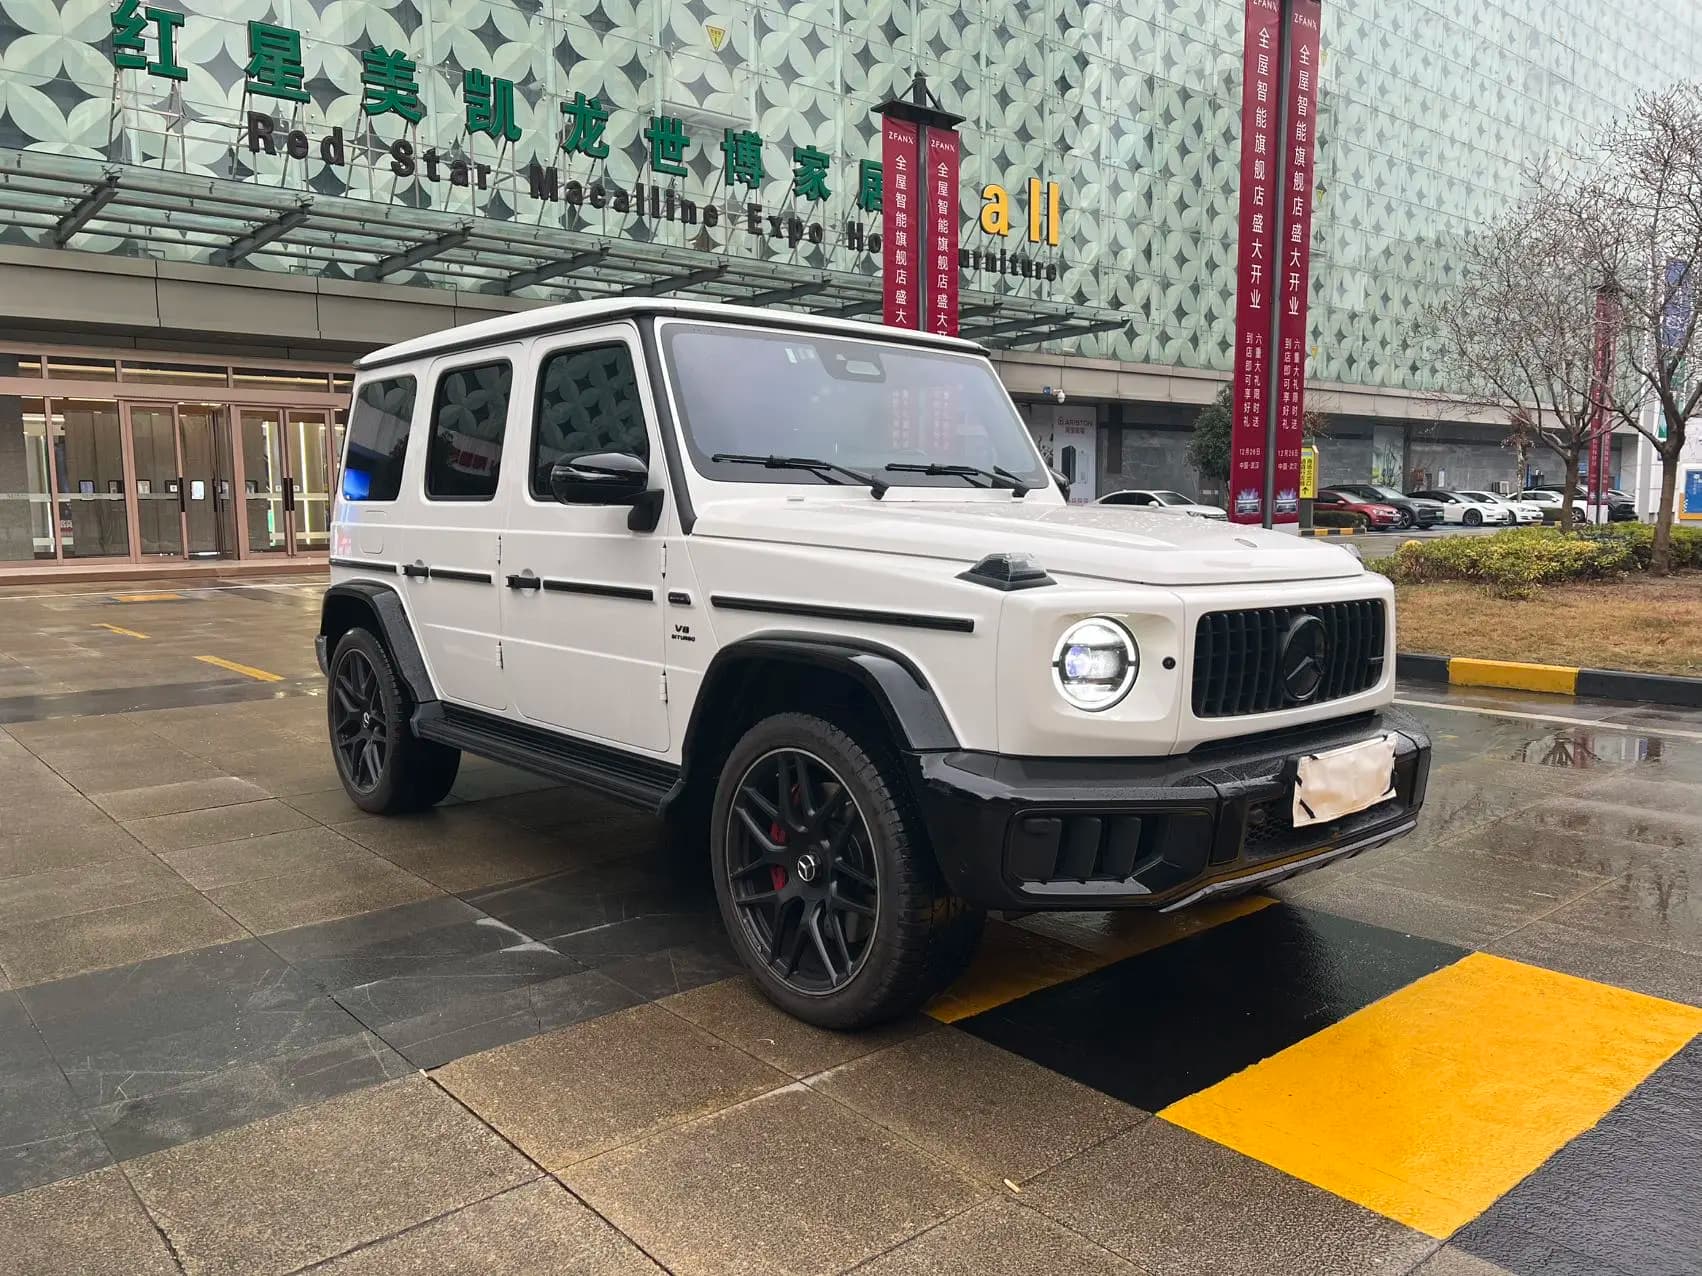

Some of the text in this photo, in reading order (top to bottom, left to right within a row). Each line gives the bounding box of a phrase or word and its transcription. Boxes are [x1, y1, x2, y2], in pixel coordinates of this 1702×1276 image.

[247, 111, 1057, 282] Red Star Macalline Expo Ho urniture
[895, 154, 907, 324] 全屋智能旗舰店盛大
[980, 177, 1059, 247] all
[1249, 27, 1270, 309] 全屋智能旗舰店盛大开业
[1288, 44, 1310, 315] 全屋智能旗舰店盛大开业
[675, 624, 689, 633] V8
